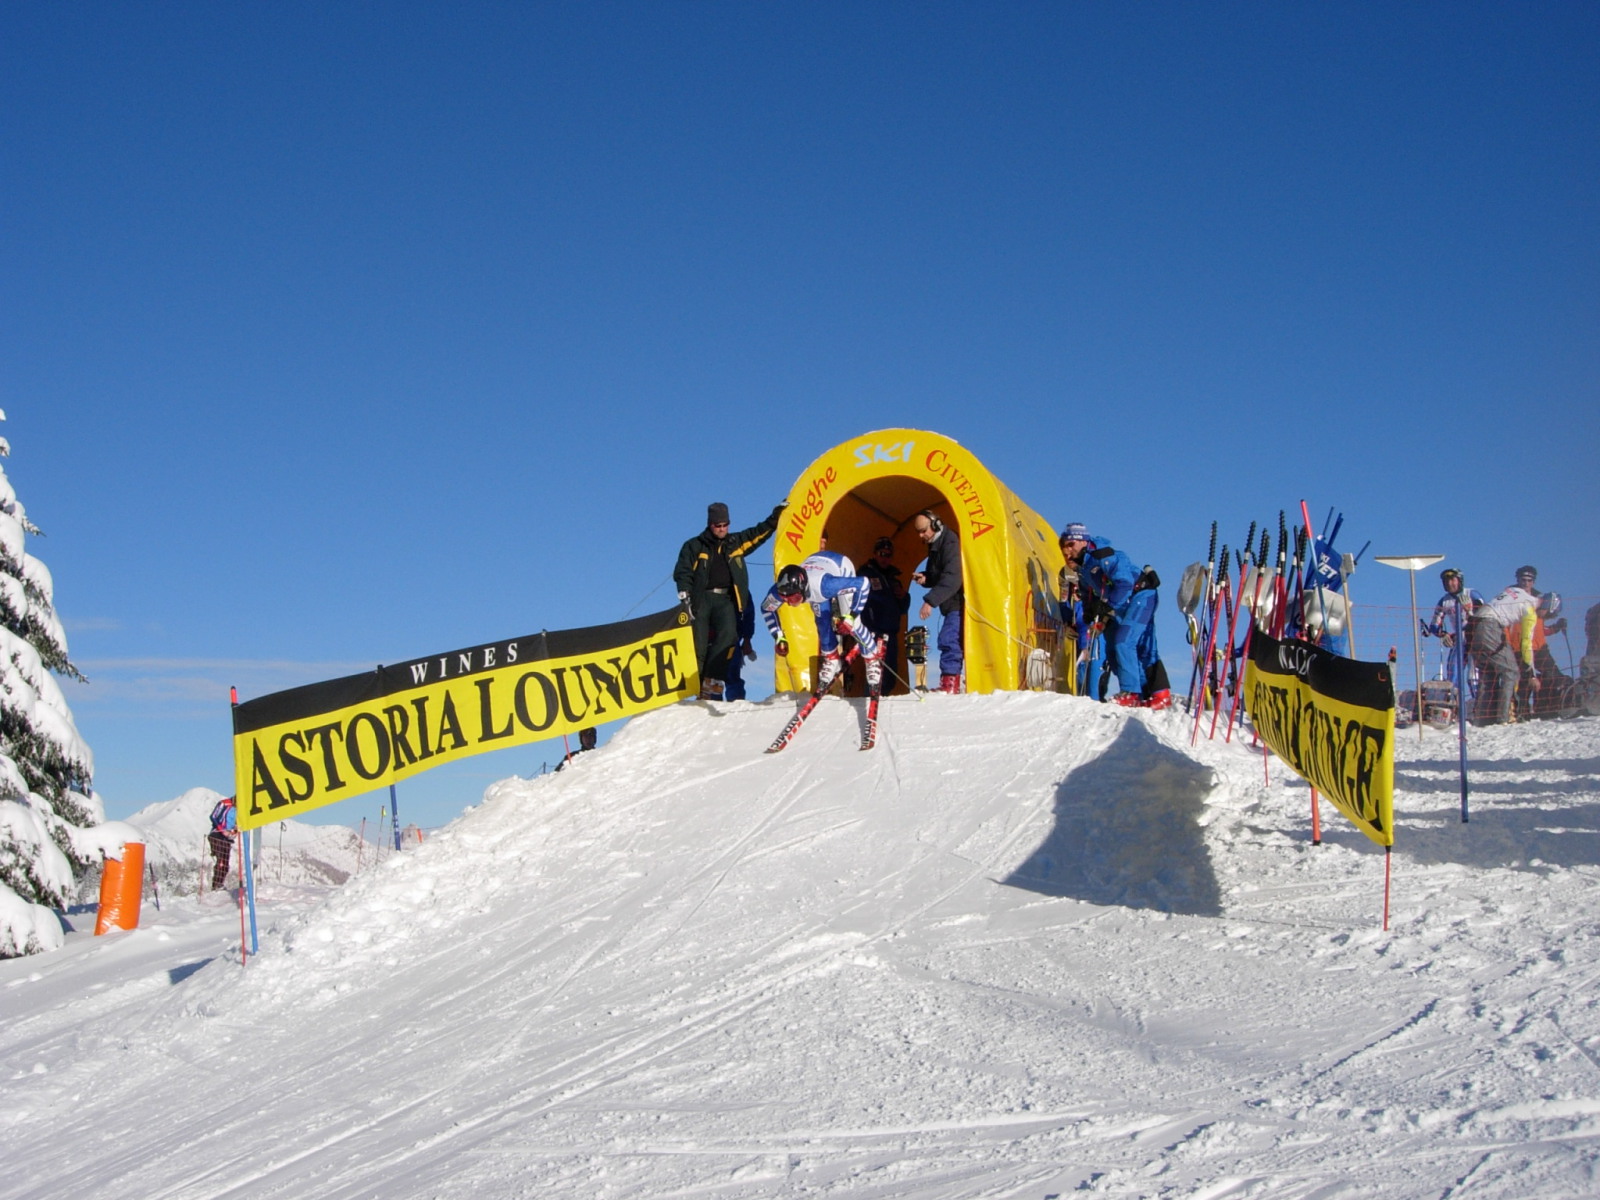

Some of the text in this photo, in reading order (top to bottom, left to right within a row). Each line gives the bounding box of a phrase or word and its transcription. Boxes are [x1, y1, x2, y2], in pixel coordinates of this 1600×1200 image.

[785, 466, 837, 552] Alleghe
[853, 442, 915, 469] SKI
[410, 642, 518, 685] WINES
[249, 638, 687, 816] ASTORIA LOUNGE
[770, 716, 802, 750] ATOMIC
[860, 719, 872, 750] ATOMIC
